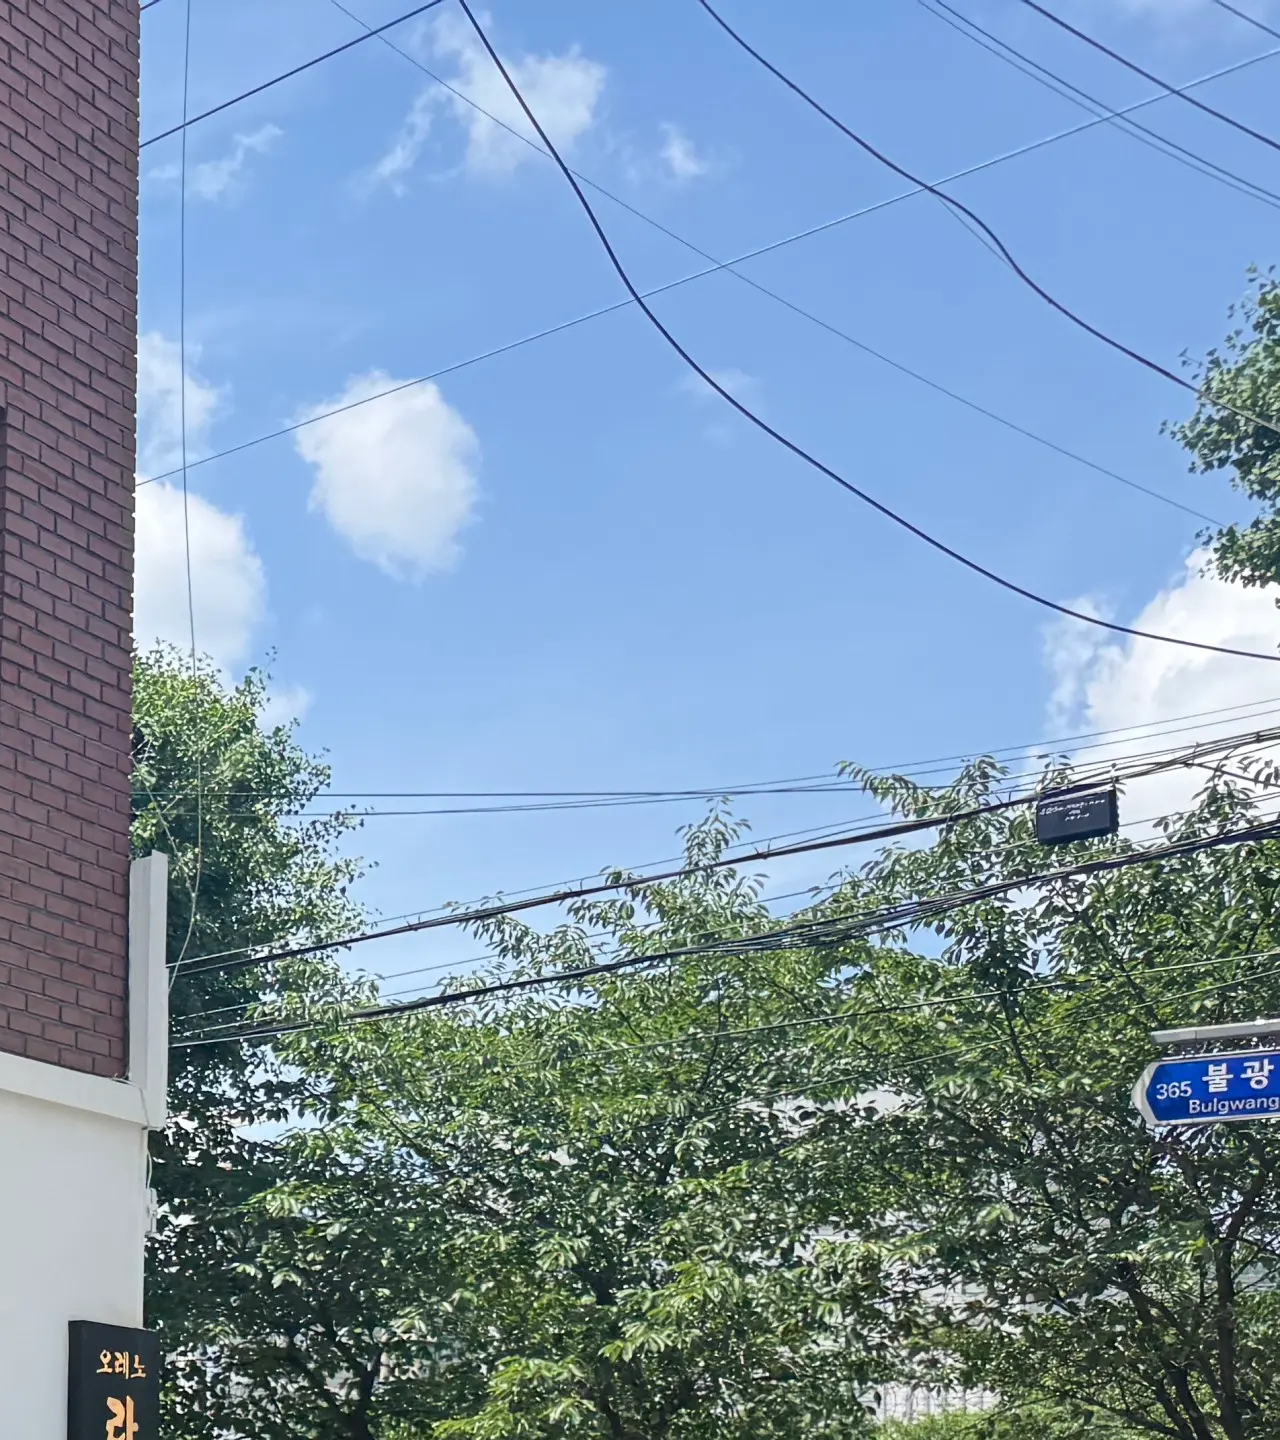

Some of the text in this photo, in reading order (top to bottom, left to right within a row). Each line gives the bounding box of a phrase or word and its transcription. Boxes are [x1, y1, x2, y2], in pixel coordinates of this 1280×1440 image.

[1202, 1058, 1274, 1093] 불광
[1156, 1081, 1192, 1100] 365
[1189, 1097, 1280, 1115] Bulgwang
[96, 1350, 147, 1379] 오레노
